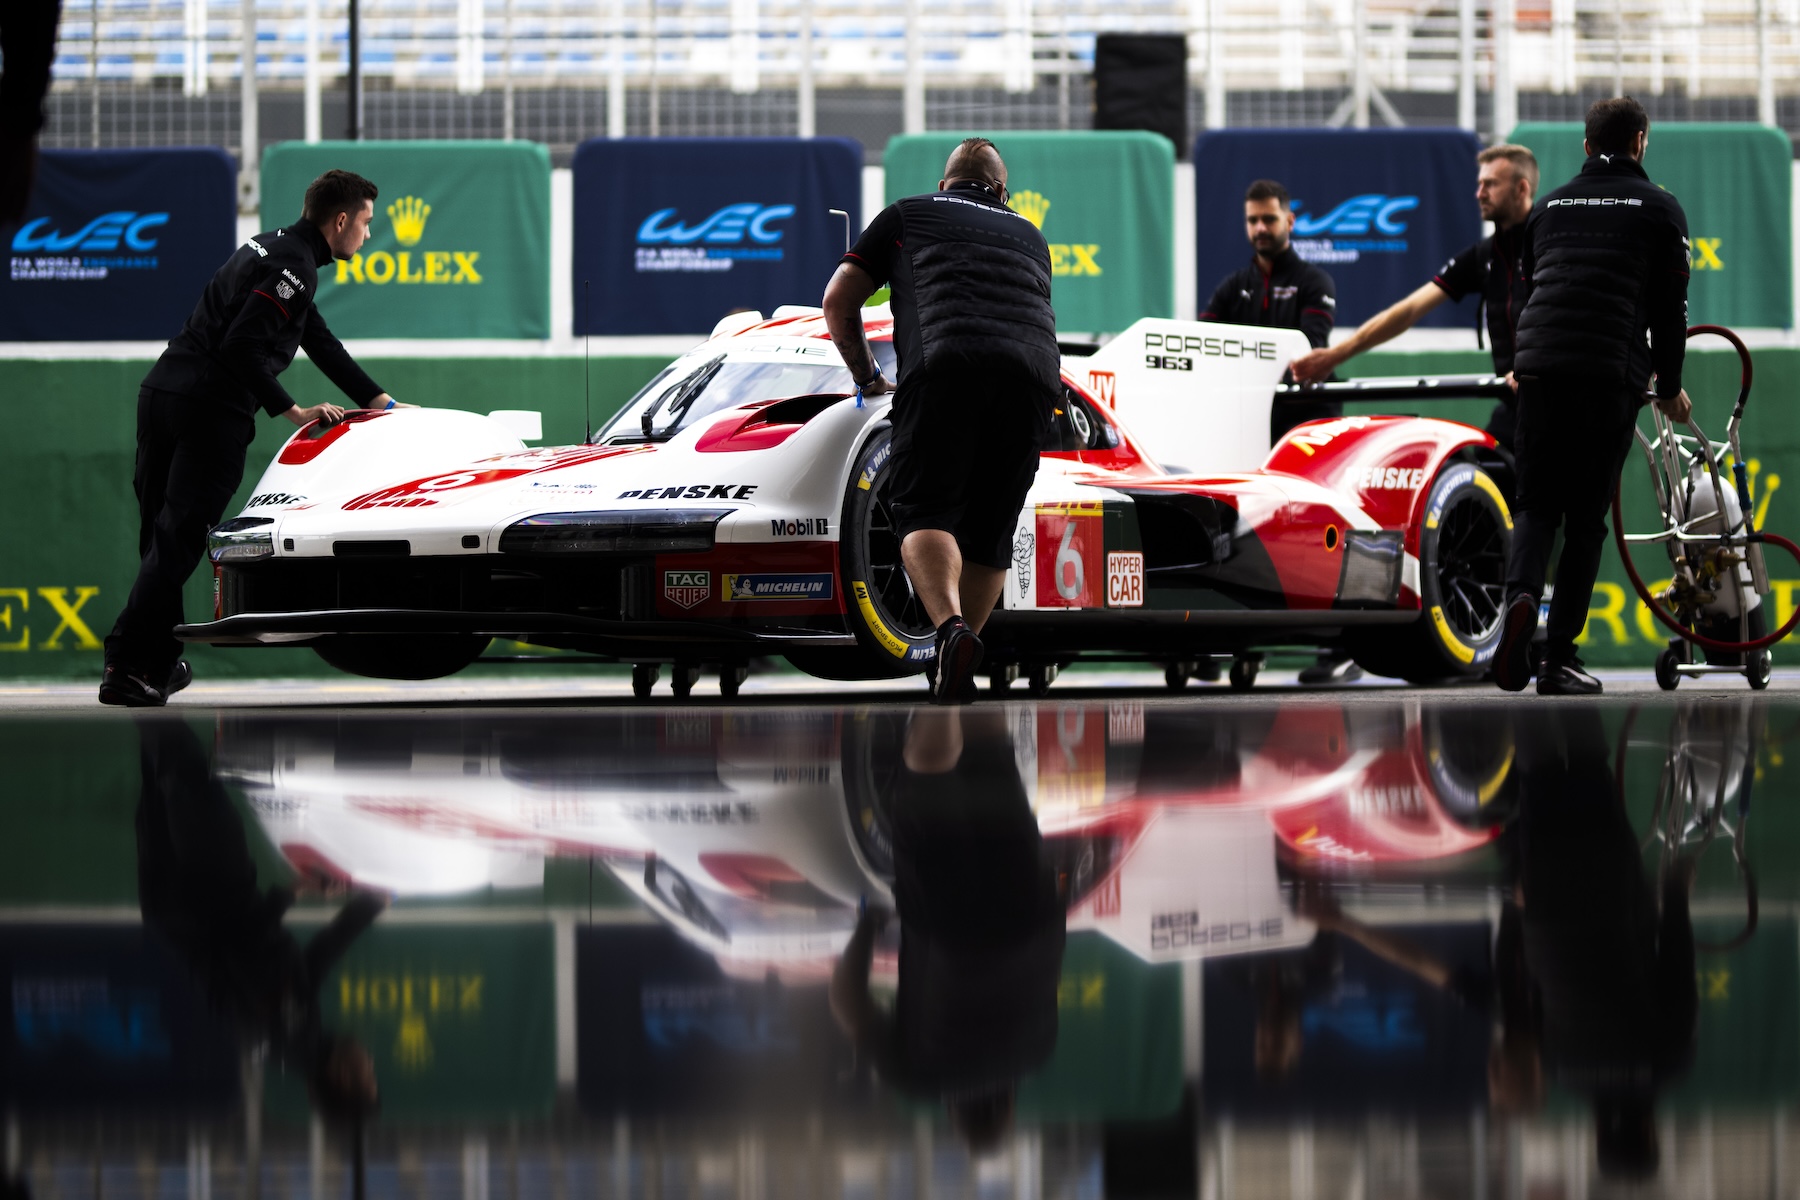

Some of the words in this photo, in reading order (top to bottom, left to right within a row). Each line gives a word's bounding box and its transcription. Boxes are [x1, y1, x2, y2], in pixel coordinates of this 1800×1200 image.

[1547, 197, 1643, 209] PORSCHE
[11, 210, 170, 252] WEC
[635, 202, 796, 244] WEC
[34, 256, 81, 268] WORLD
[334, 250, 483, 285] ROLEX
[281, 268, 301, 287] Mobil
[1145, 332, 1277, 361] PORSCHE
[1145, 354, 1193, 372] 963
[615, 484, 759, 500] PENSKE
[771, 518, 814, 536] Mobil
[816, 518, 829, 536] 1
[1055, 521, 1084, 601] 6
[1109, 556, 1142, 574] HYPER
[668, 573, 706, 586] TAG
[755, 581, 824, 594] MICHELIN
[1109, 574, 1142, 602] CAR
[667, 587, 708, 603] HEUER
